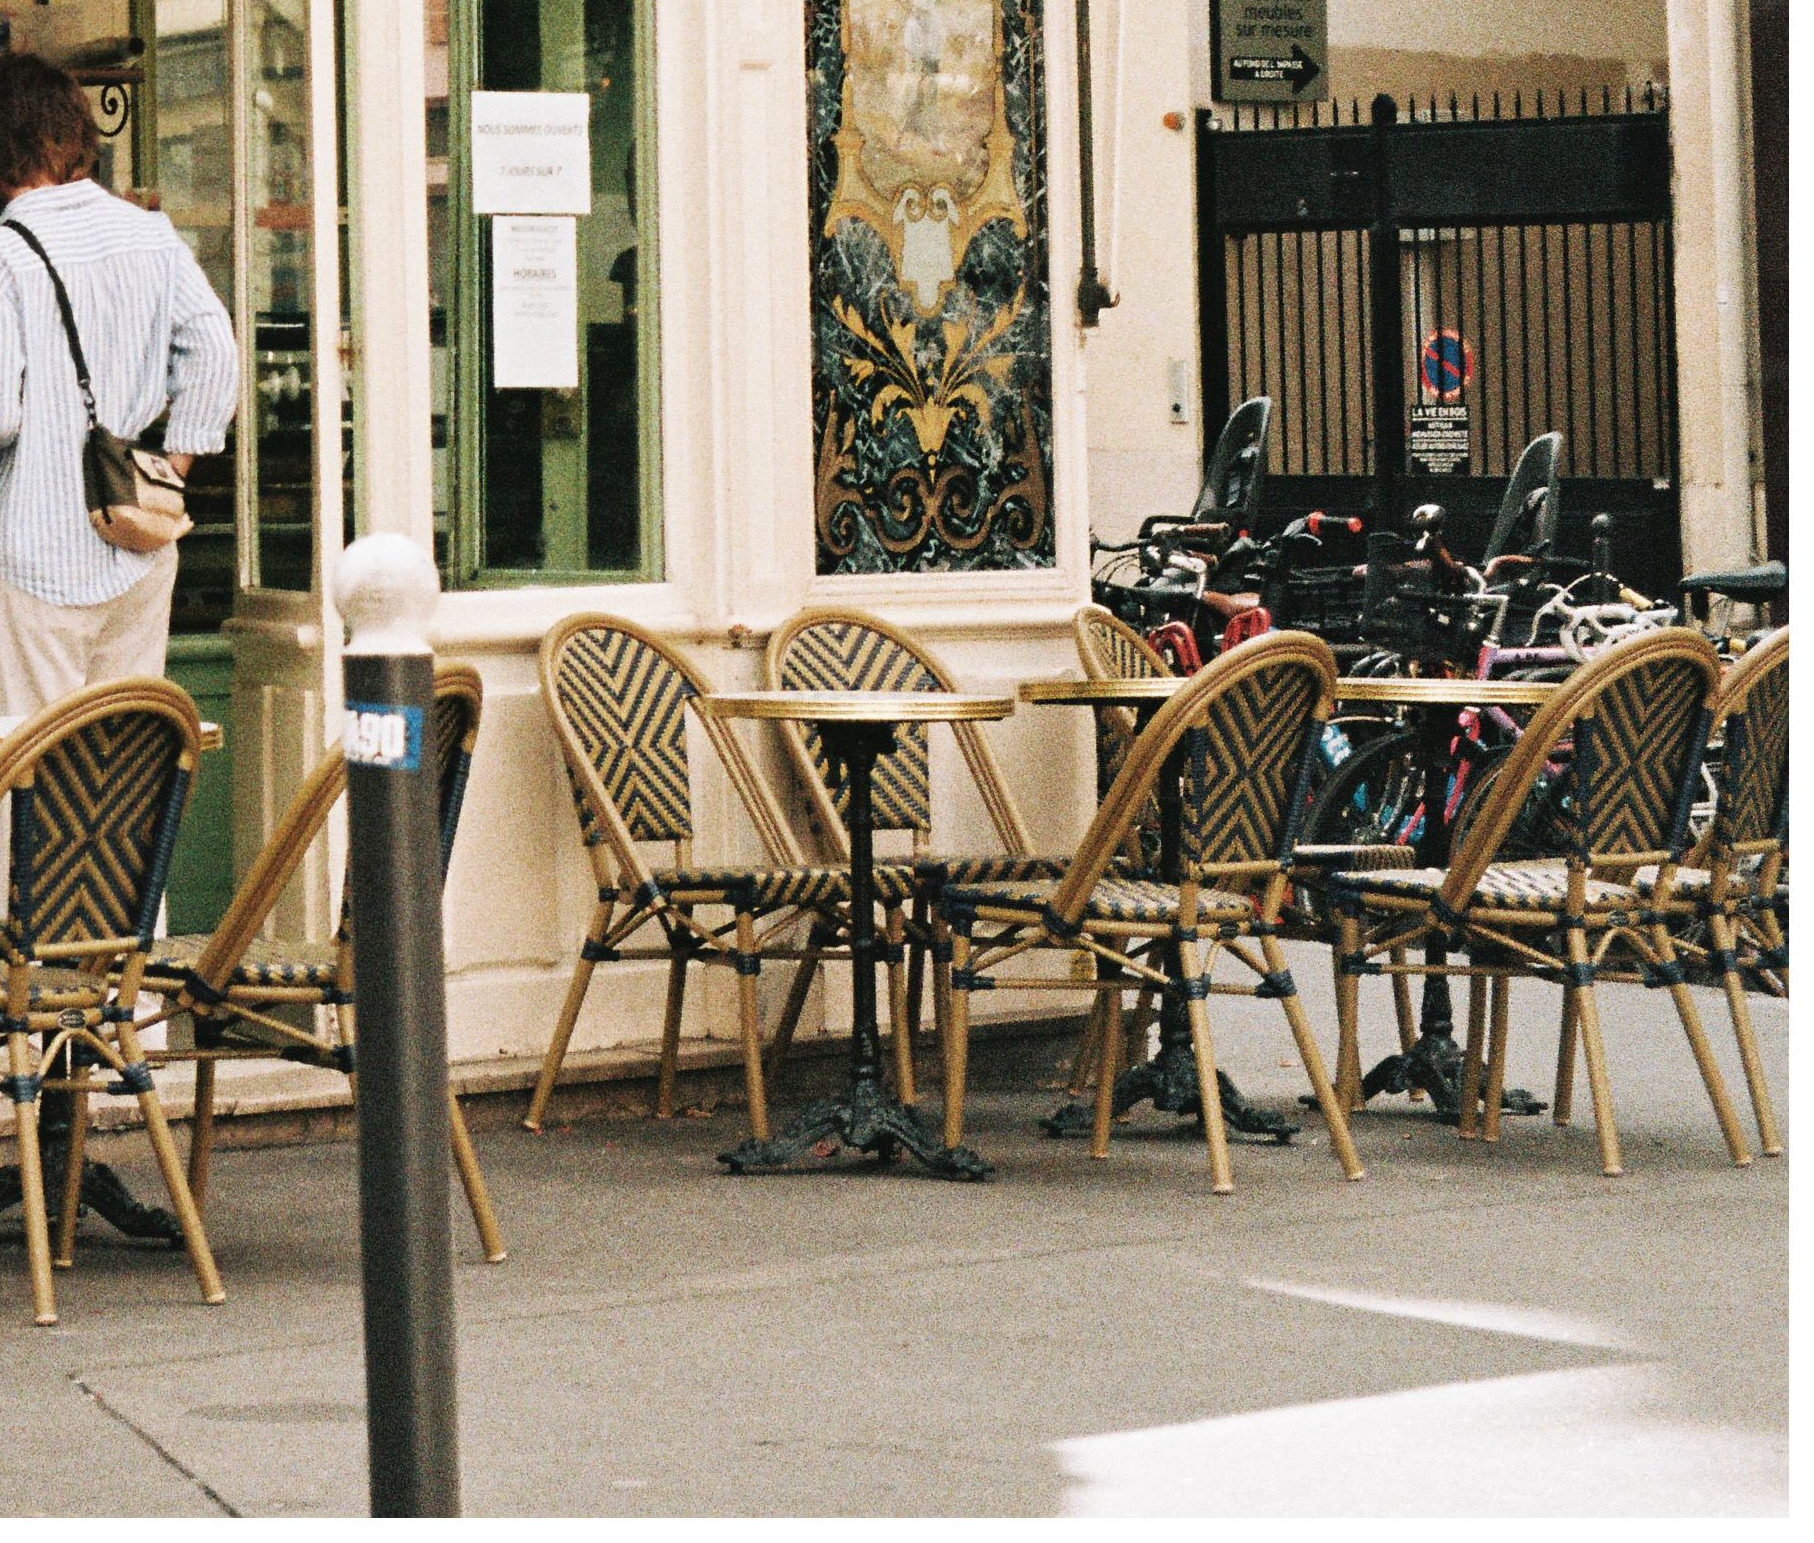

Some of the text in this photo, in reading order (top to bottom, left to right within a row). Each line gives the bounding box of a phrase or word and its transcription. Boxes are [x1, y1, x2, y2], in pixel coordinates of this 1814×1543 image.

[1243, 4, 1305, 21] meubles
[1236, 24, 1313, 38] sur mesure
[477, 124, 583, 136] NOUS SOMMES OUVERTS
[536, 166, 554, 177] SUR
[555, 165, 563, 176] 7
[512, 268, 557, 281] HORAIRES
[1412, 407, 1423, 417] LA
[1425, 407, 1436, 417] VIE
[1450, 407, 1467, 417] BOIS
